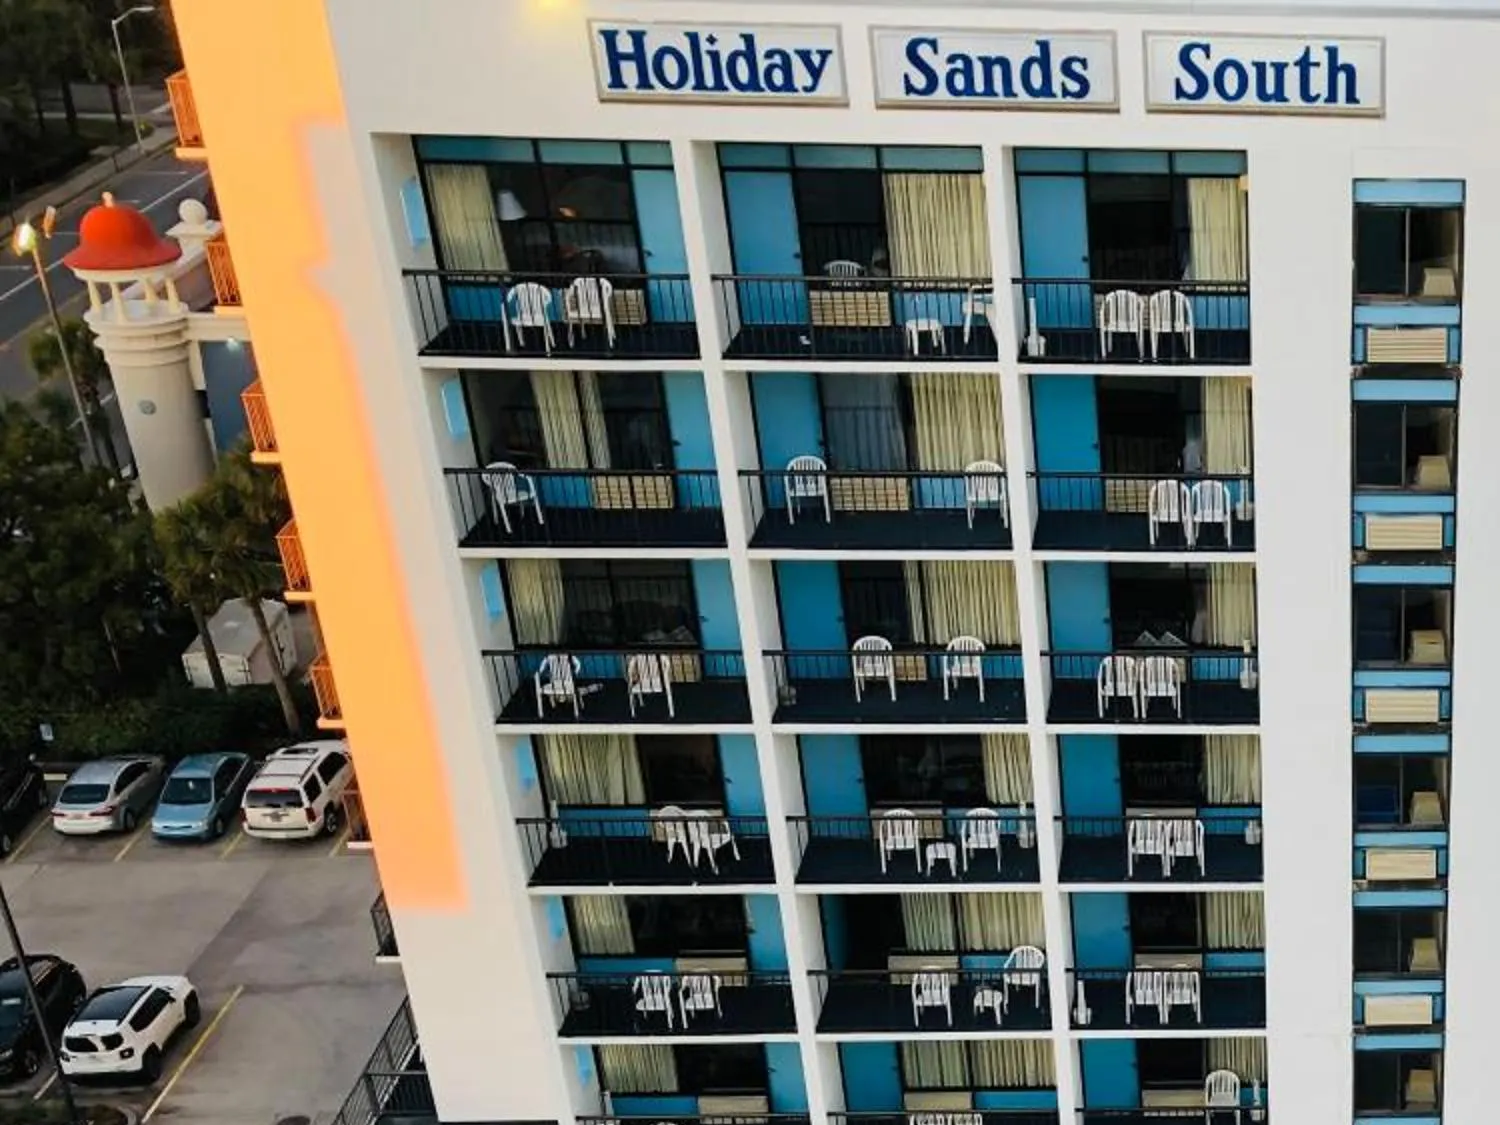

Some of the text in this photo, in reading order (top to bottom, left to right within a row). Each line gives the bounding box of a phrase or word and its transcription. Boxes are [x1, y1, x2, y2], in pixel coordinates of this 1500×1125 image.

[598, 29, 1360, 105] Holiday Sands South
